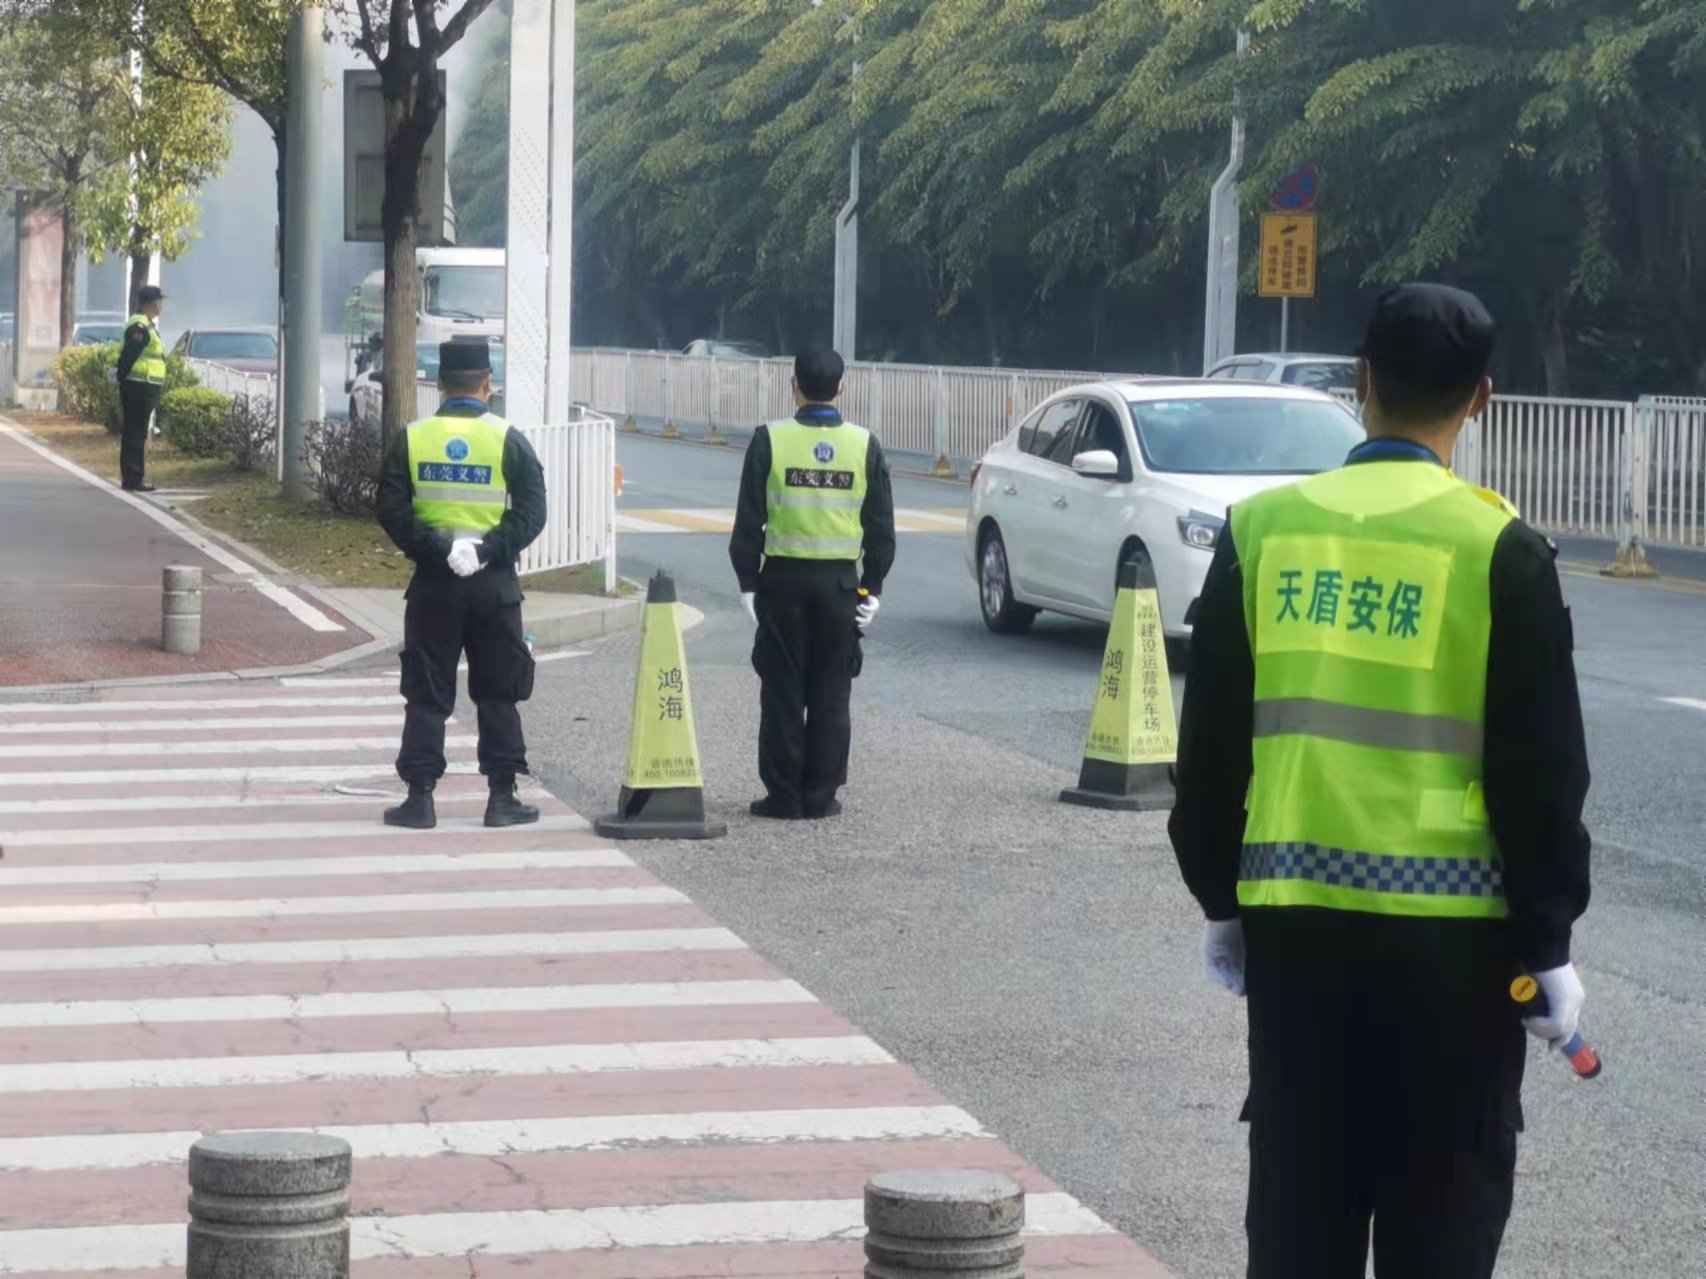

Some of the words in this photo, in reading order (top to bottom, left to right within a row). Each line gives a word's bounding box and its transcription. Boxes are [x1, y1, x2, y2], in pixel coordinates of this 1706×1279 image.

[1276, 569, 1423, 639] 天盾安保
[657, 667, 684, 721] 鸿海
[1101, 648, 1124, 701] 鸿海
[1140, 623, 1161, 733] 建设运营停车场
